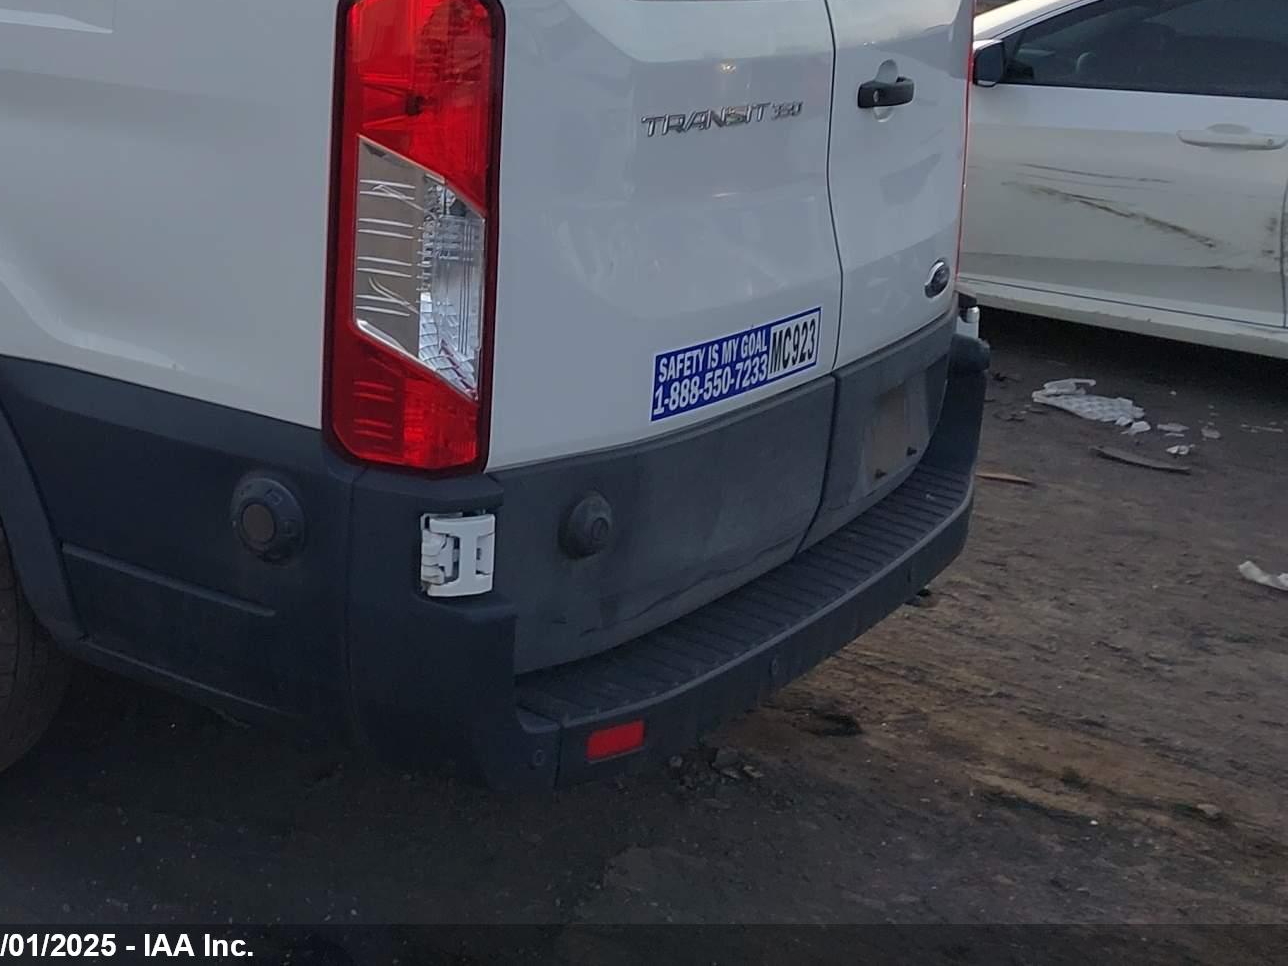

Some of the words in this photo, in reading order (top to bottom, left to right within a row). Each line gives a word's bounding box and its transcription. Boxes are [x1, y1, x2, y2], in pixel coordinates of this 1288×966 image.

[641, 101, 771, 138] TRANSIT
[658, 346, 706, 383] SAFETY
[707, 342, 720, 370] IS
[722, 337, 740, 365] MY
[740, 329, 768, 359] GOAL
[770, 318, 816, 374] MC923
[653, 354, 768, 415] 1-888-550-7233
